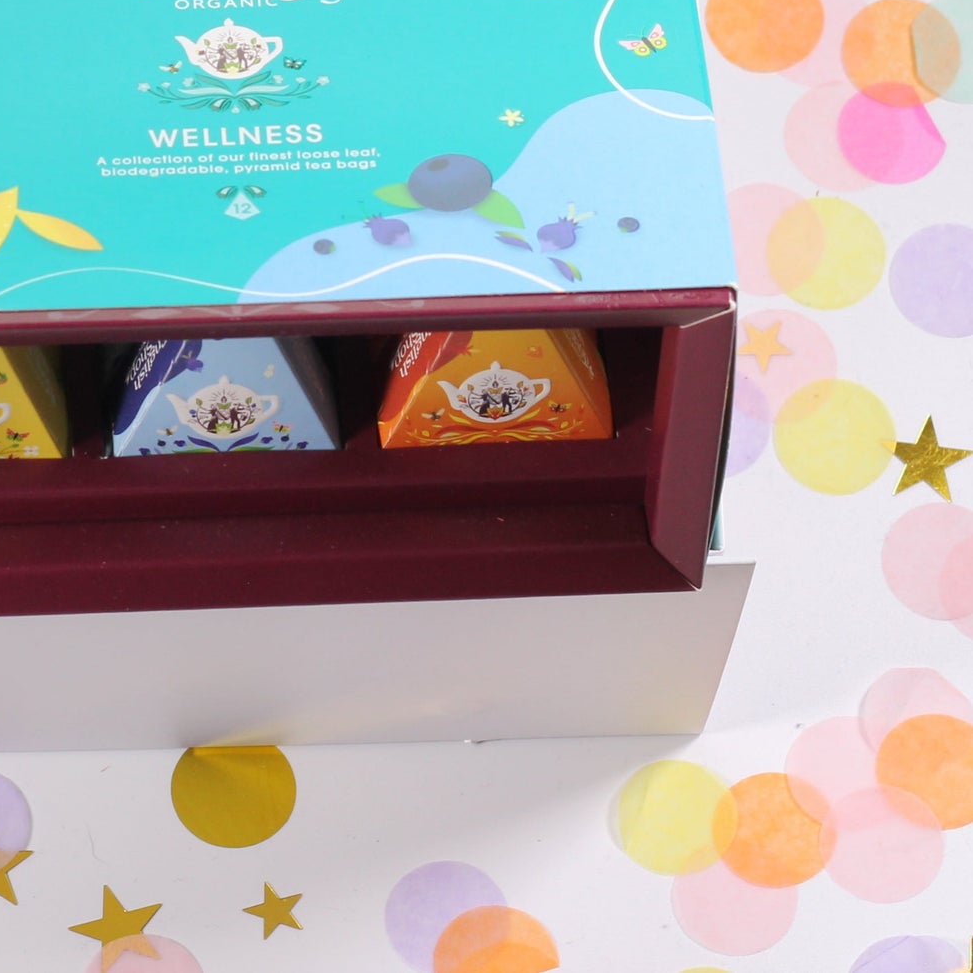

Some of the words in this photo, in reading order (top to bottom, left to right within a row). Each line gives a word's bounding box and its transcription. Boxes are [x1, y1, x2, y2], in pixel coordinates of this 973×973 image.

[148, 123, 324, 148] WELLNESS
[96, 157, 107, 165] A
[112, 154, 192, 165] collection
[198, 153, 214, 163] of
[218, 153, 244, 162] our
[249, 150, 292, 162] finest
[297, 150, 340, 160] loose
[101, 164, 229, 177] biodegradable,
[234, 162, 300, 174] pyramid
[306, 161, 331, 170] tea
[336, 159, 377, 170] bags
[233, 203, 252, 215] 12
[399, 331, 432, 378] nglish
